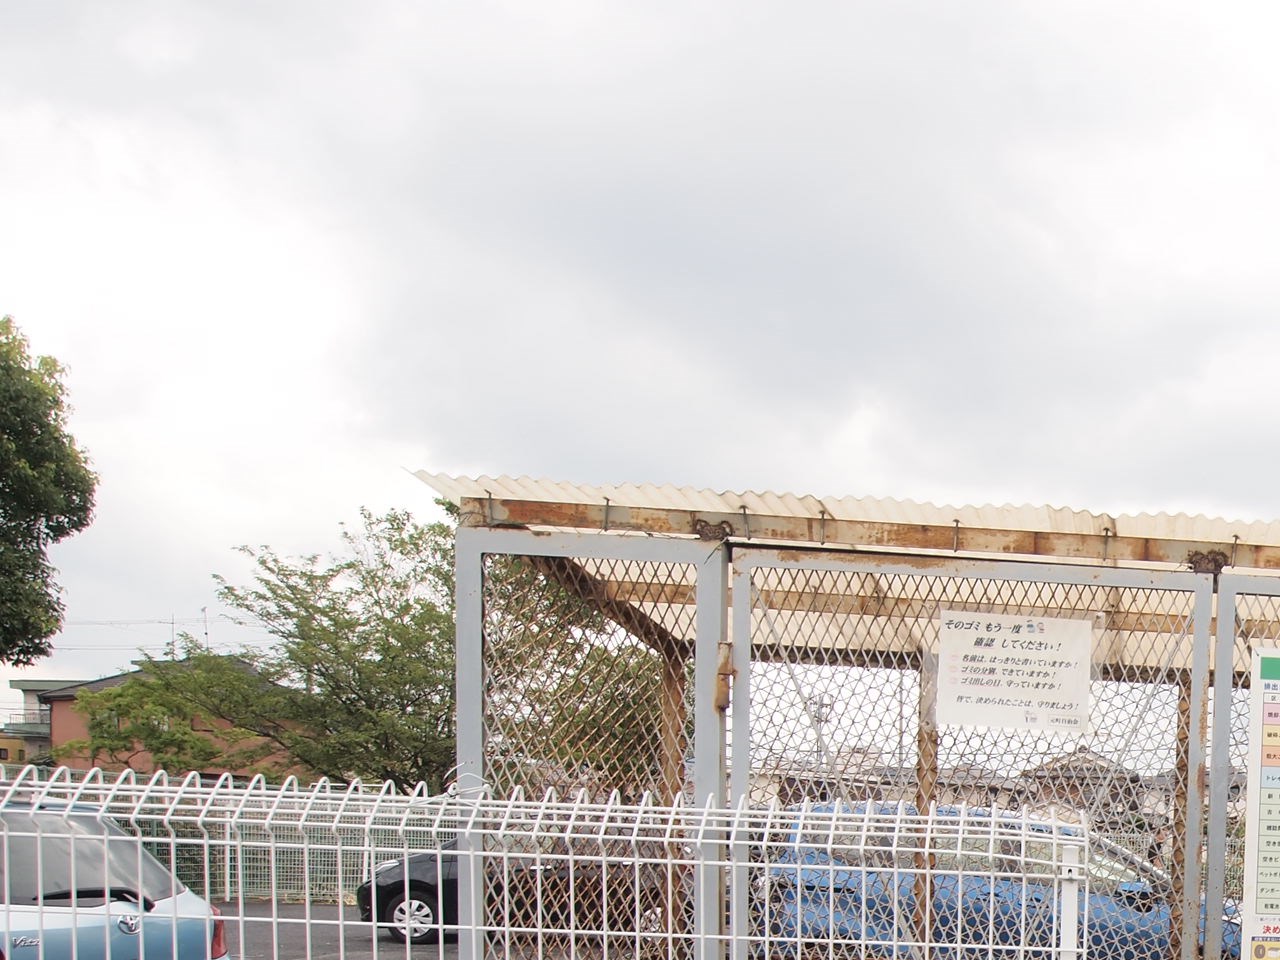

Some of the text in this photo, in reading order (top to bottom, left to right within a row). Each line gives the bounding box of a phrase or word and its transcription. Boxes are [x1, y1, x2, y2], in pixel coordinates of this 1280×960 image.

[945, 619, 1023, 634] そのゴミ もう一度
[974, 637, 1063, 651] 確認 してください！
